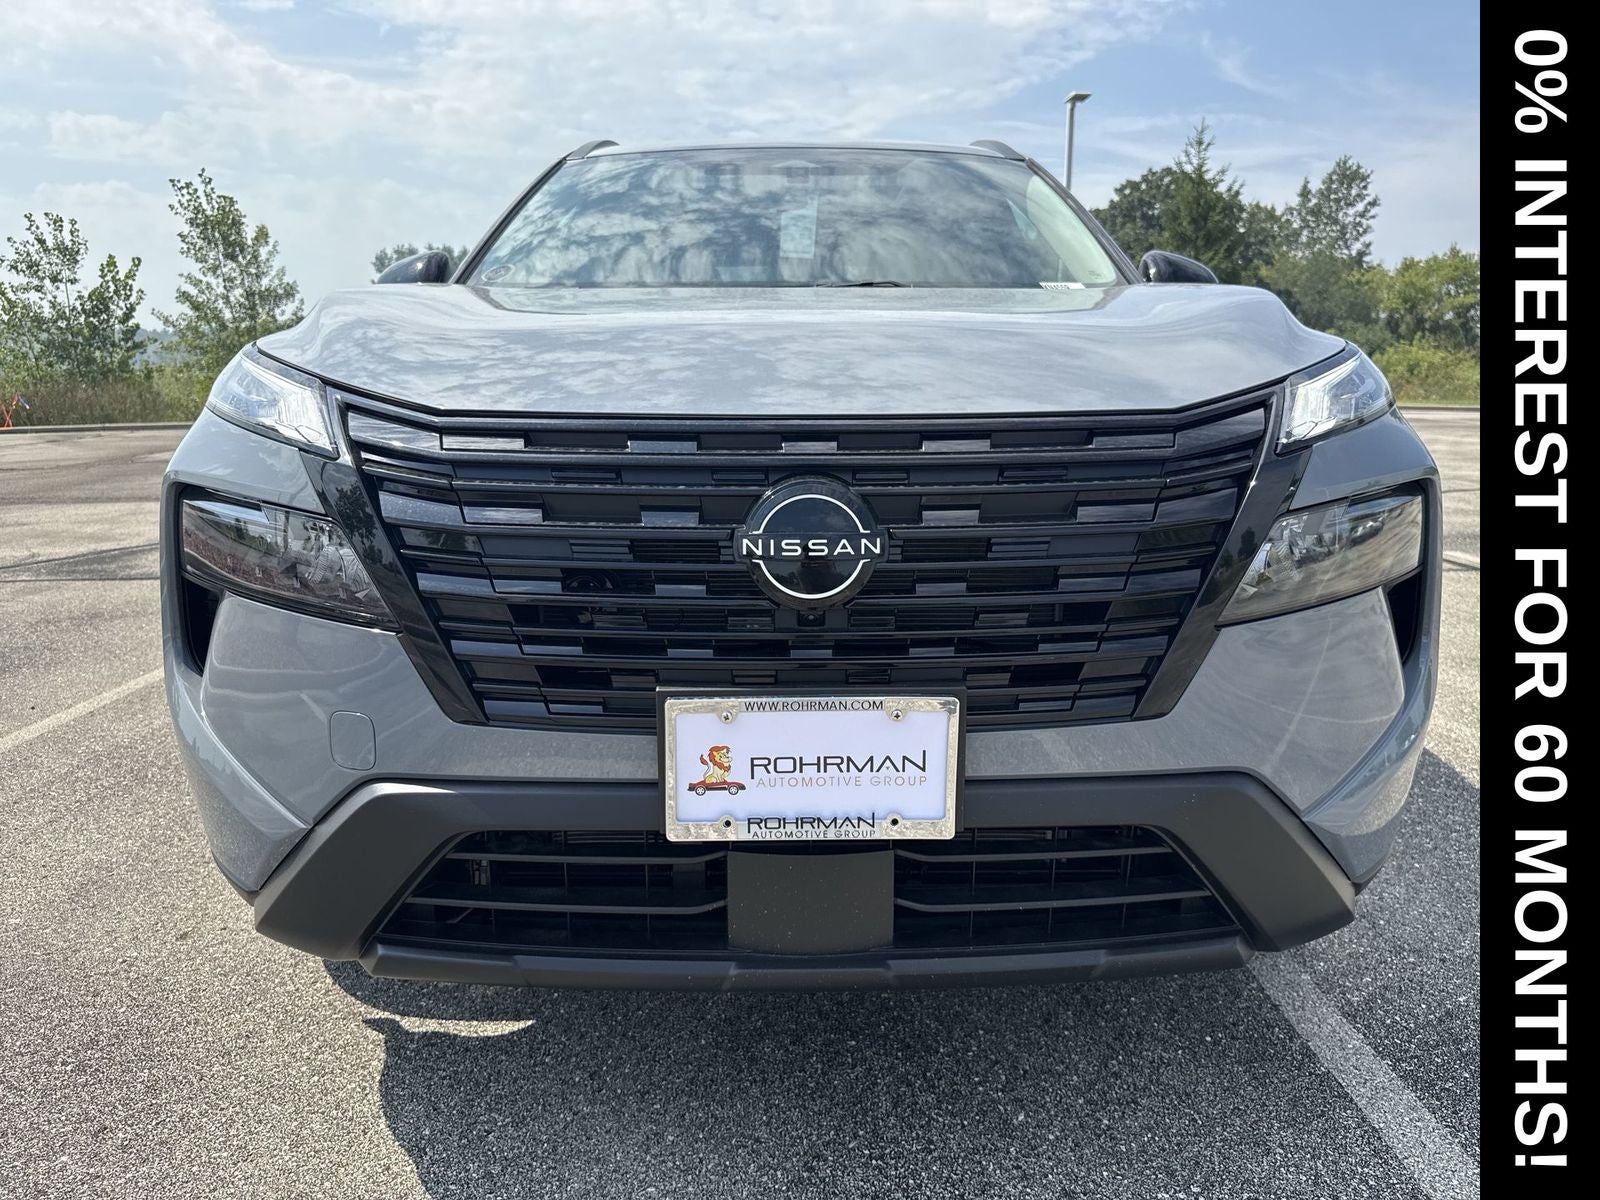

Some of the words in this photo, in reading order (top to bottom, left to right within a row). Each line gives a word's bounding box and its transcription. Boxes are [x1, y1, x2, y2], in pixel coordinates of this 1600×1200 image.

[742, 537, 881, 556] NISSAN
[744, 700, 884, 712] WWW.ROHRMAN.COM
[750, 750, 927, 780] ROHRMAN
[756, 776, 862, 788] AUTOMOTIVE
[870, 775, 927, 787] GROUP
[747, 812, 876, 834] ROHRMAN
[752, 829, 832, 840] AUTOMOTIVE
[835, 829, 876, 839] GROUP
